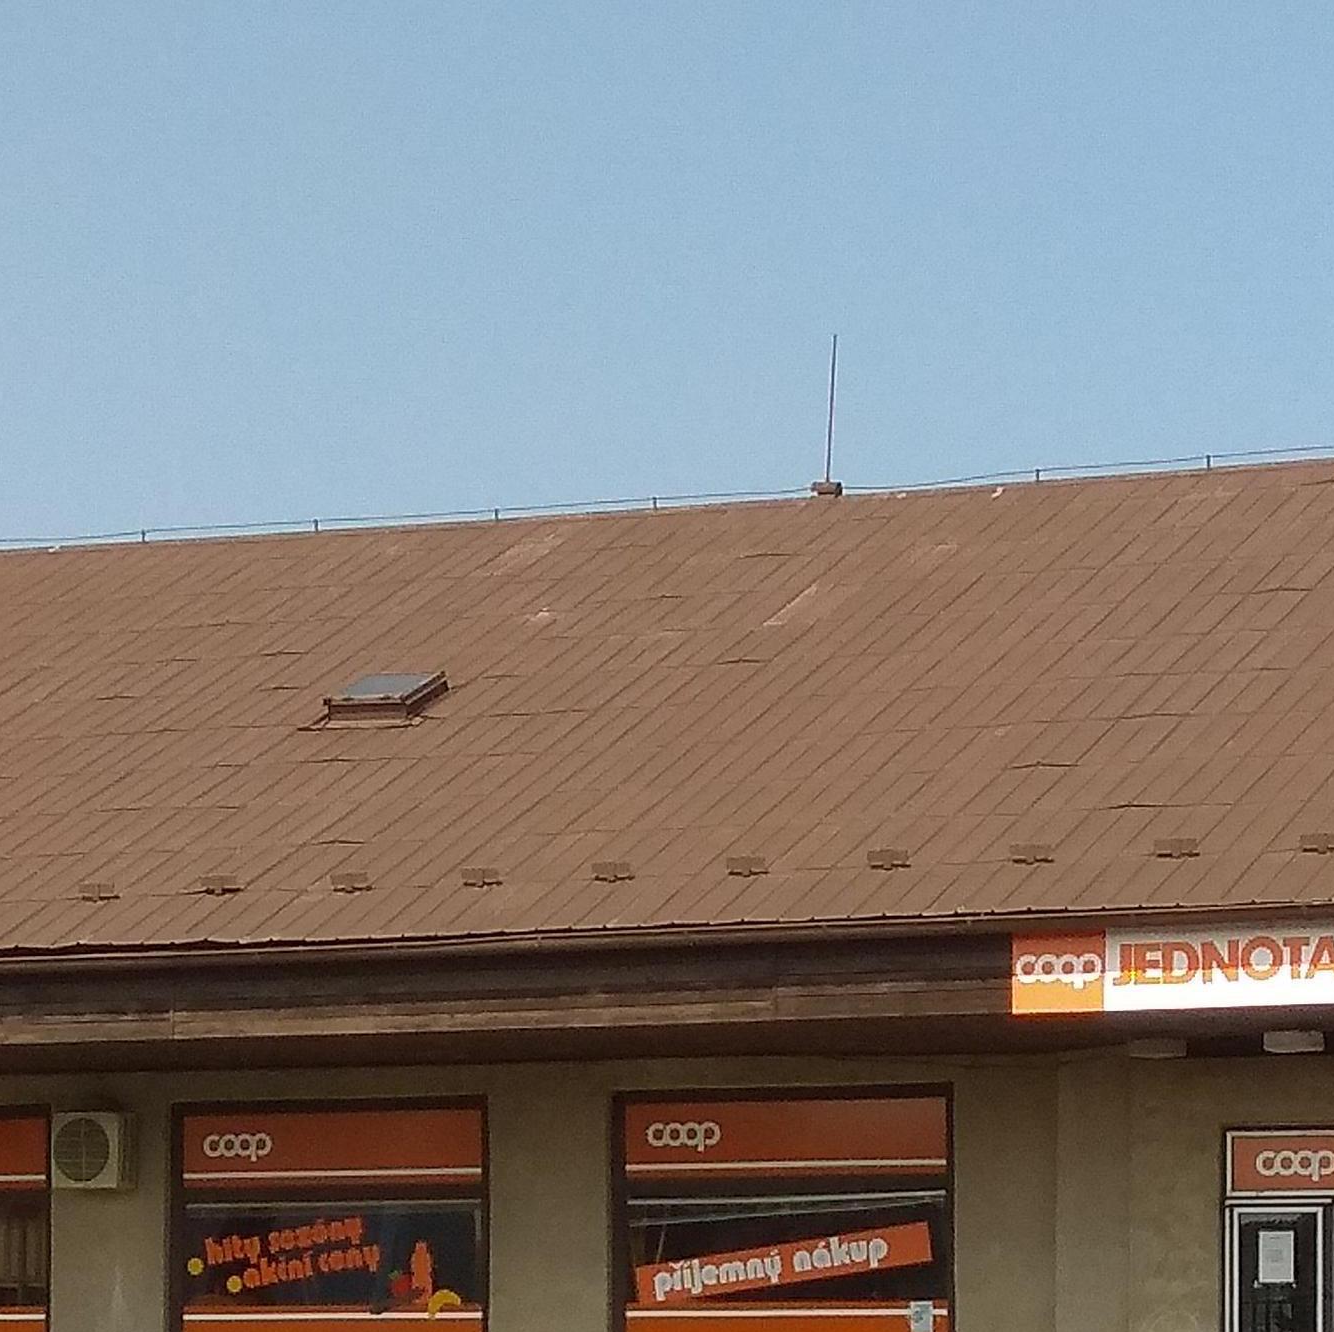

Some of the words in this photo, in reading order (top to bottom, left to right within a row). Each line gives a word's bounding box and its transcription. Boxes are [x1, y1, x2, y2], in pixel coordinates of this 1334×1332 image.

[1016, 953, 1102, 990] coop
[203, 1133, 272, 1162] coop
[647, 1121, 721, 1152] coop
[792, 1236, 889, 1269] nákup
